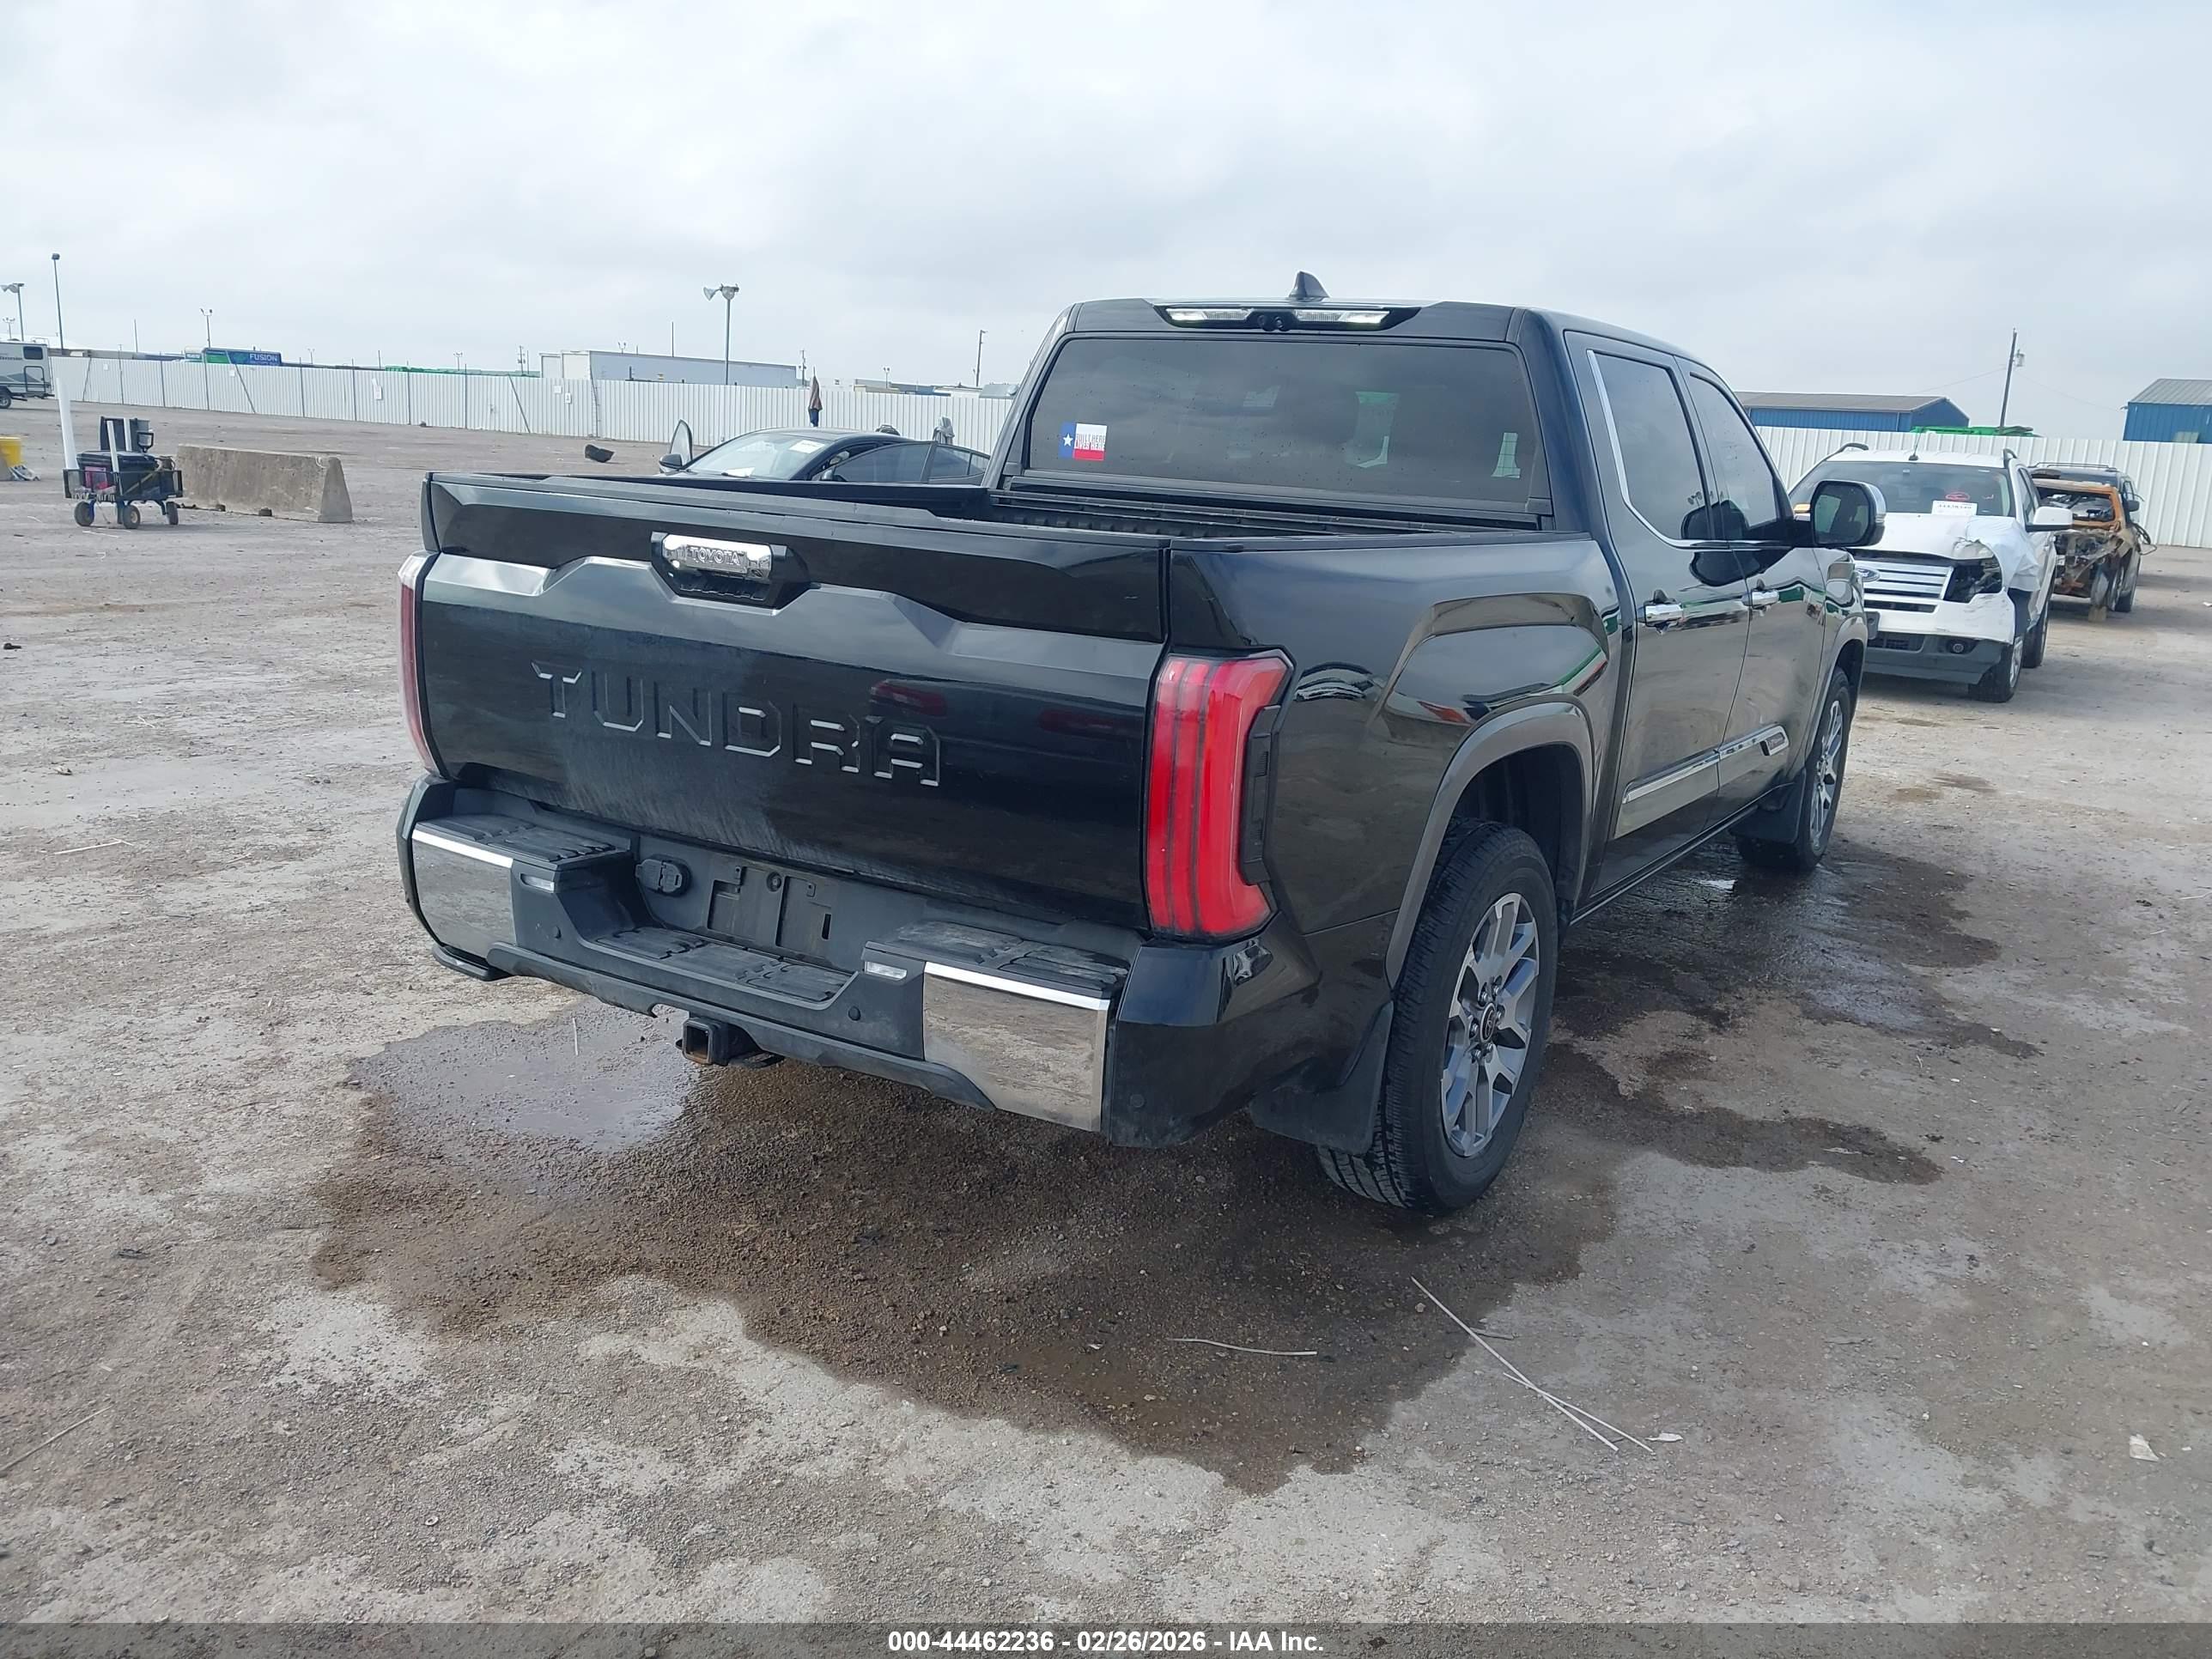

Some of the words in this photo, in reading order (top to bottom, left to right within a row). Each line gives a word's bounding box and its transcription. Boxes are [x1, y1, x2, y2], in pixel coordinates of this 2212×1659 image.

[249, 353, 277, 362] FUSION
[1074, 440, 1090, 450] LIVES
[1091, 441, 1105, 452] HERE
[690, 546, 740, 565] TOYOTA
[531, 660, 939, 787] TUNDRA
